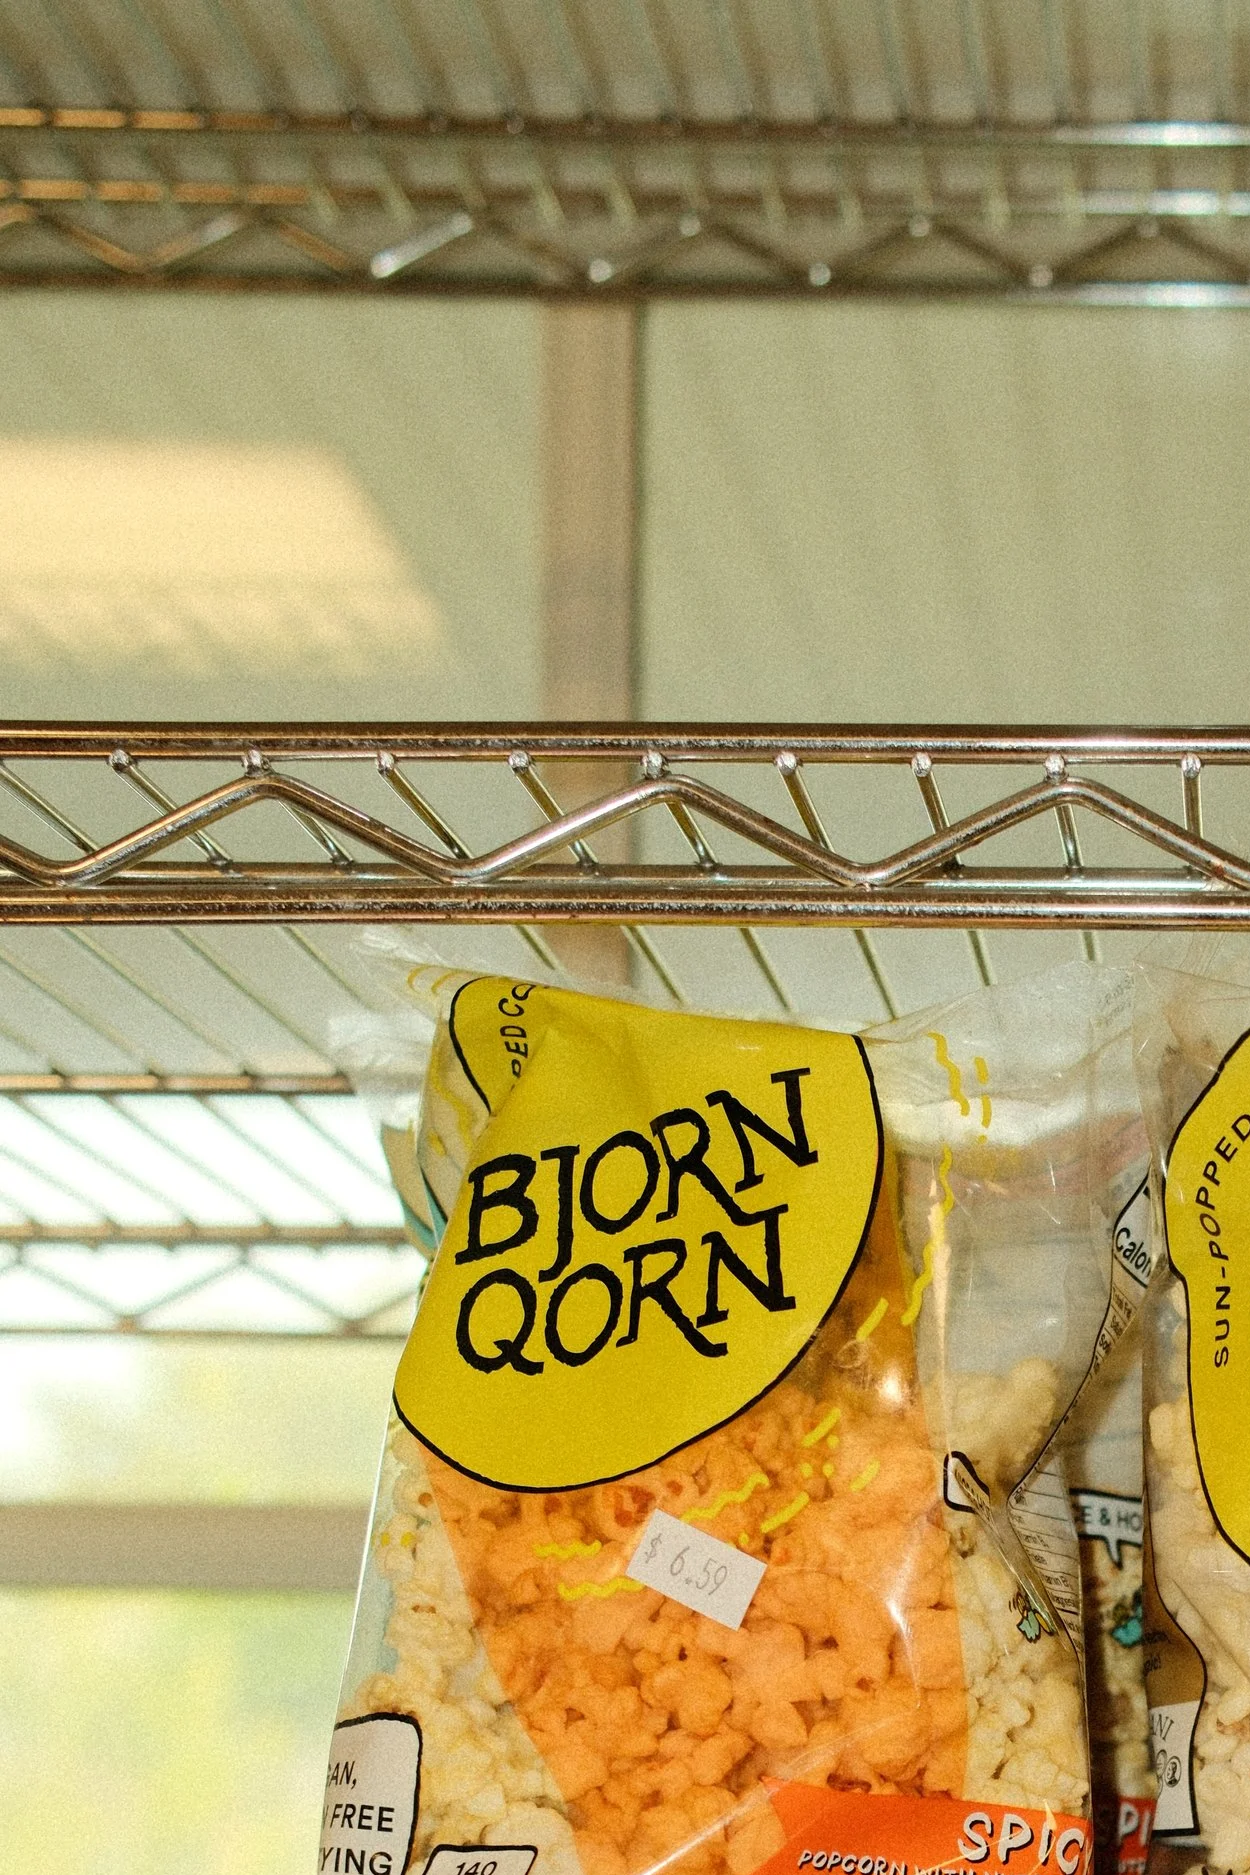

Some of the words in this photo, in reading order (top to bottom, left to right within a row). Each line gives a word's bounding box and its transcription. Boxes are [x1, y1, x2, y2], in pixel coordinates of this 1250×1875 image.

[454, 1066, 820, 1278] BJORN
[454, 1202, 797, 1376] QORN
[669, 1545, 729, 1597] 6.59
[331, 1803, 395, 1833] FREE
